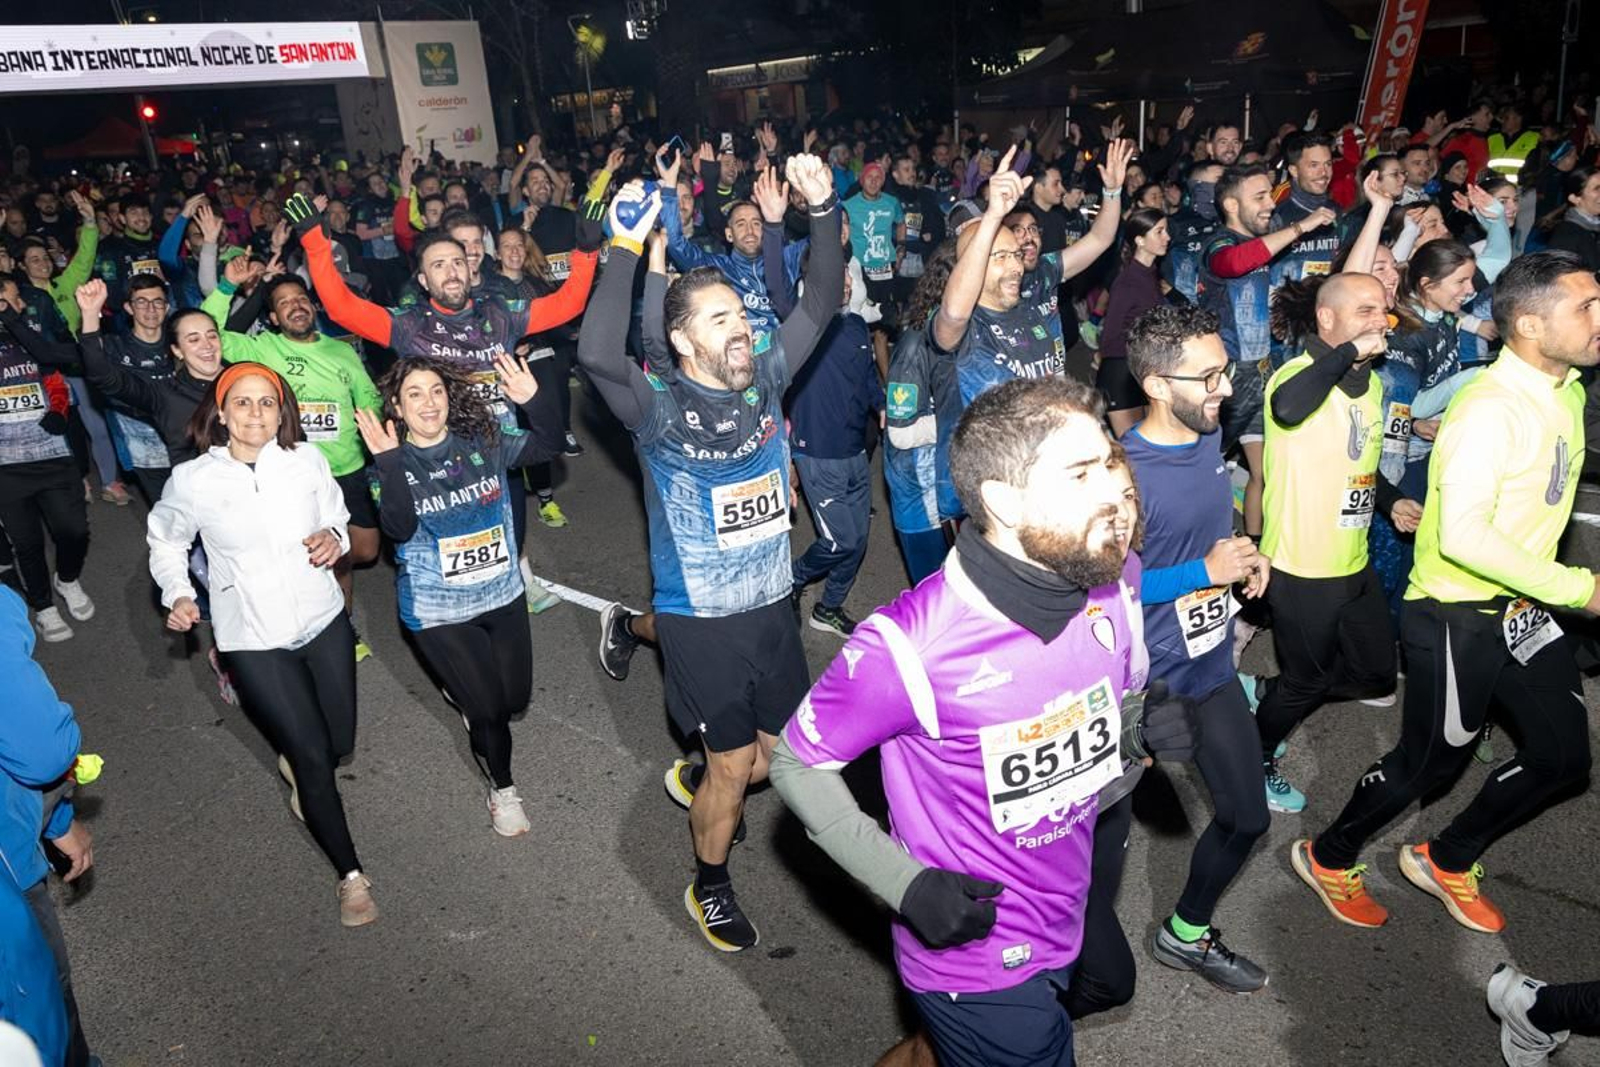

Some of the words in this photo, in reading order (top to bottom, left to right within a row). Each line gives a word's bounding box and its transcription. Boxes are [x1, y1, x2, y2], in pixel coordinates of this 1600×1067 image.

[0, 50, 47, 72] BANA
[48, 46, 198, 71] INTERNACIONAL
[199, 45, 254, 66] NOCHE
[255, 44, 278, 64] DE
[278, 43, 309, 64] SAN
[417, 96, 468, 108] calderón
[1291, 240, 1314, 253] SAN
[1315, 235, 1340, 251] ANTÓ
[431, 342, 462, 358] SAN
[286, 362, 305, 377] 22
[0, 394, 41, 411] 9793
[682, 442, 728, 460] SAN
[414, 495, 446, 516] SAN
[449, 475, 500, 508] ANTÓN
[722, 489, 780, 525] 5501
[446, 541, 501, 570] 7587
[1000, 716, 1111, 788] 6513
[1015, 822, 1072, 850] Paraíso
